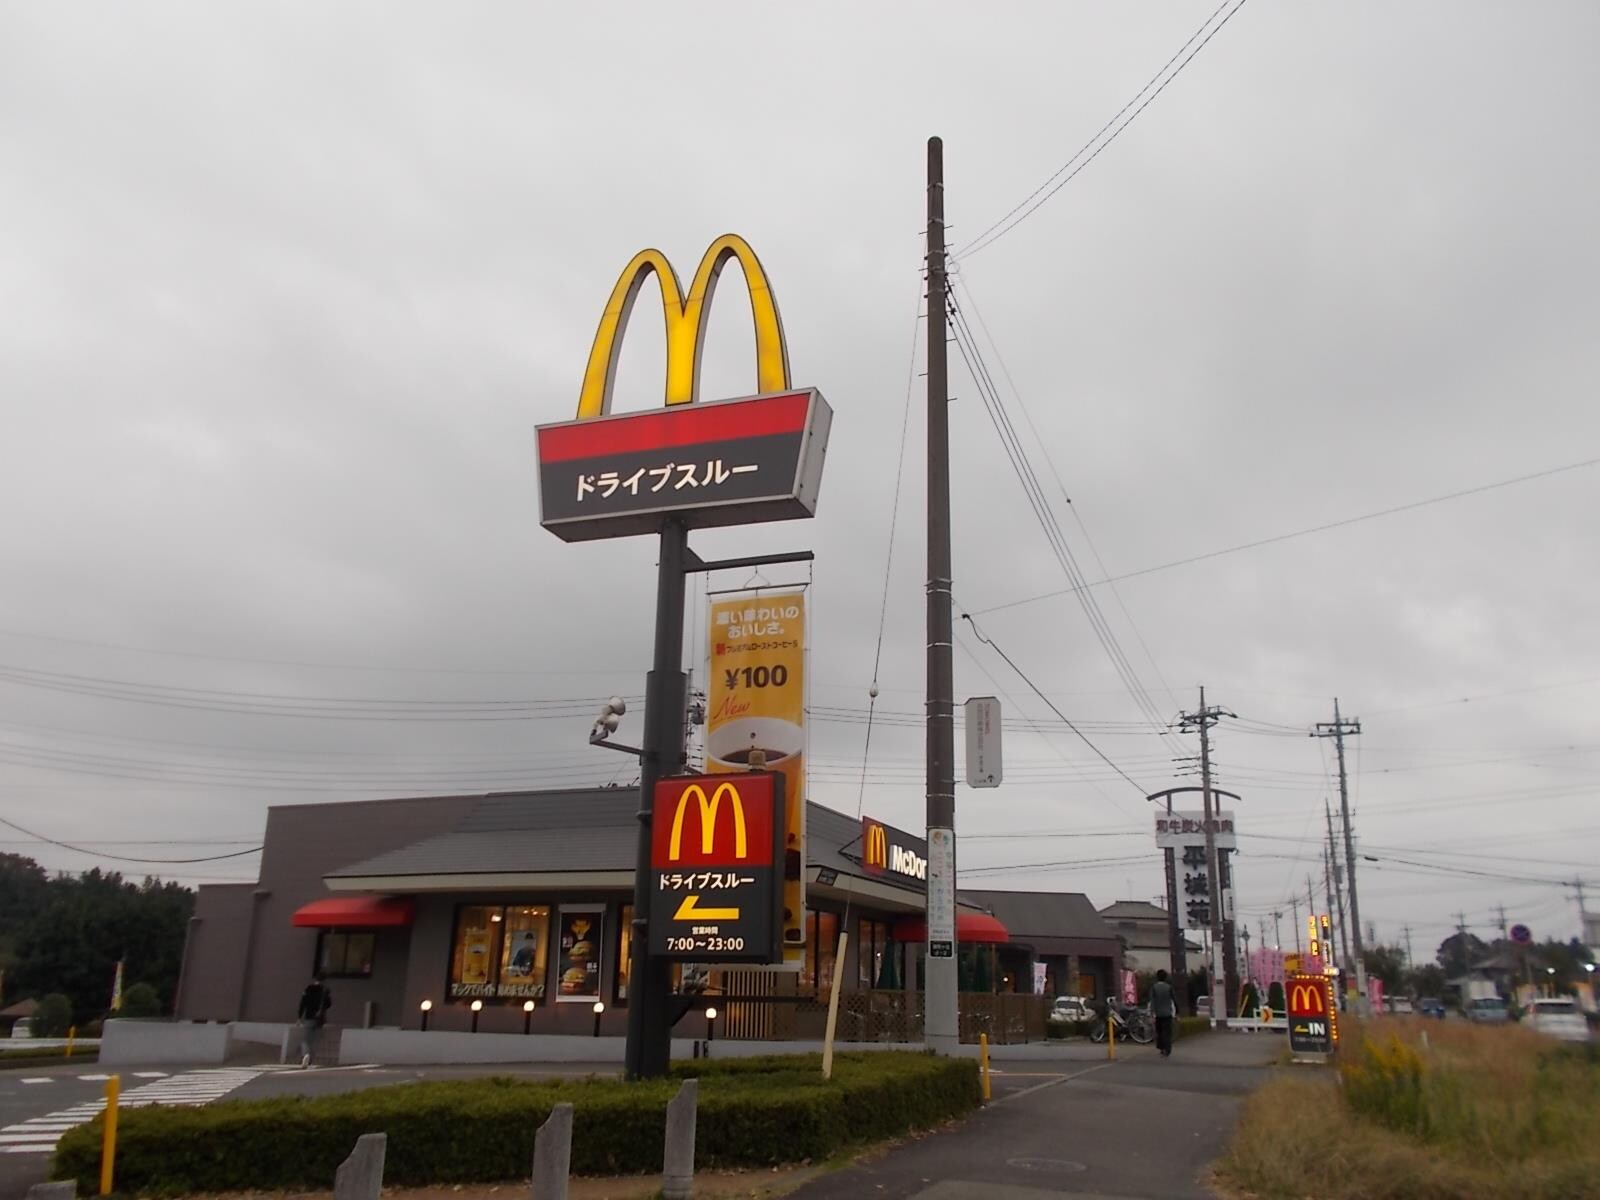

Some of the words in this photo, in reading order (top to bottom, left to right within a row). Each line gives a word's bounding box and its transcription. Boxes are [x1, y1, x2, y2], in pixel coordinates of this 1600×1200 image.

[576, 459, 758, 501] ドライブスルー
[659, 872, 755, 890] ドライブスルー
[692, 926, 719, 935] 営業時間
[1308, 1022, 1326, 1036] IN
